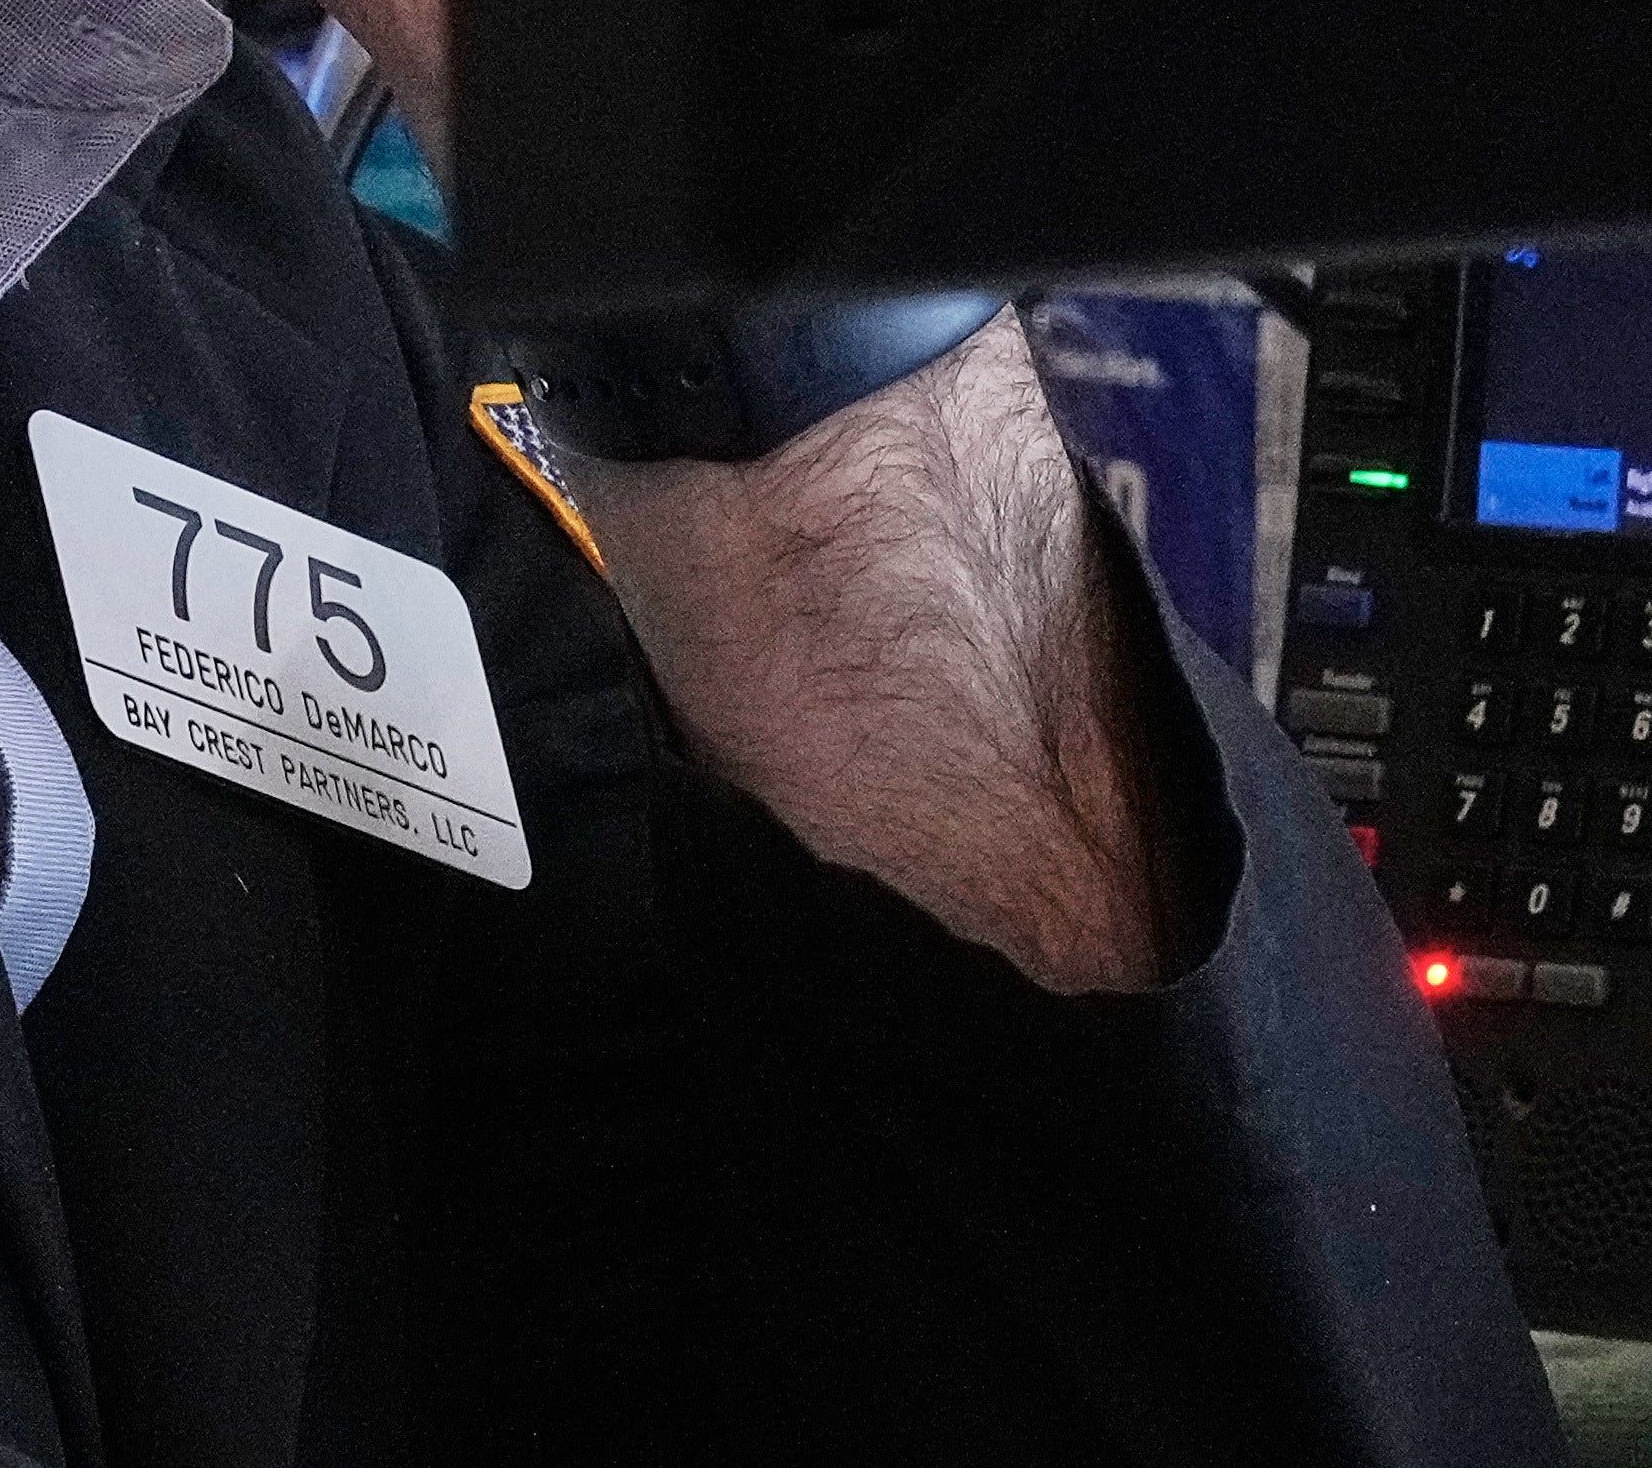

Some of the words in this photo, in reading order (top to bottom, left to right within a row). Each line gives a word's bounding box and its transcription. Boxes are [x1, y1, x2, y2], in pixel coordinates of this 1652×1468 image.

[131, 486, 387, 693] 775
[1480, 610, 1494, 639] 1
[1560, 613, 1580, 645] 2
[135, 626, 284, 716] FEDERICO
[301, 690, 448, 780] DeMARCO
[1466, 700, 1486, 730] 4
[1550, 704, 1571, 734] 5
[123, 693, 172, 739] BAY
[187, 718, 266, 774] CREST
[431, 812, 479, 858] LLC
[1457, 790, 1477, 822] 7
[1538, 797, 1558, 829] 8
[1622, 803, 1642, 834] 9
[1528, 883, 1549, 914] 0
